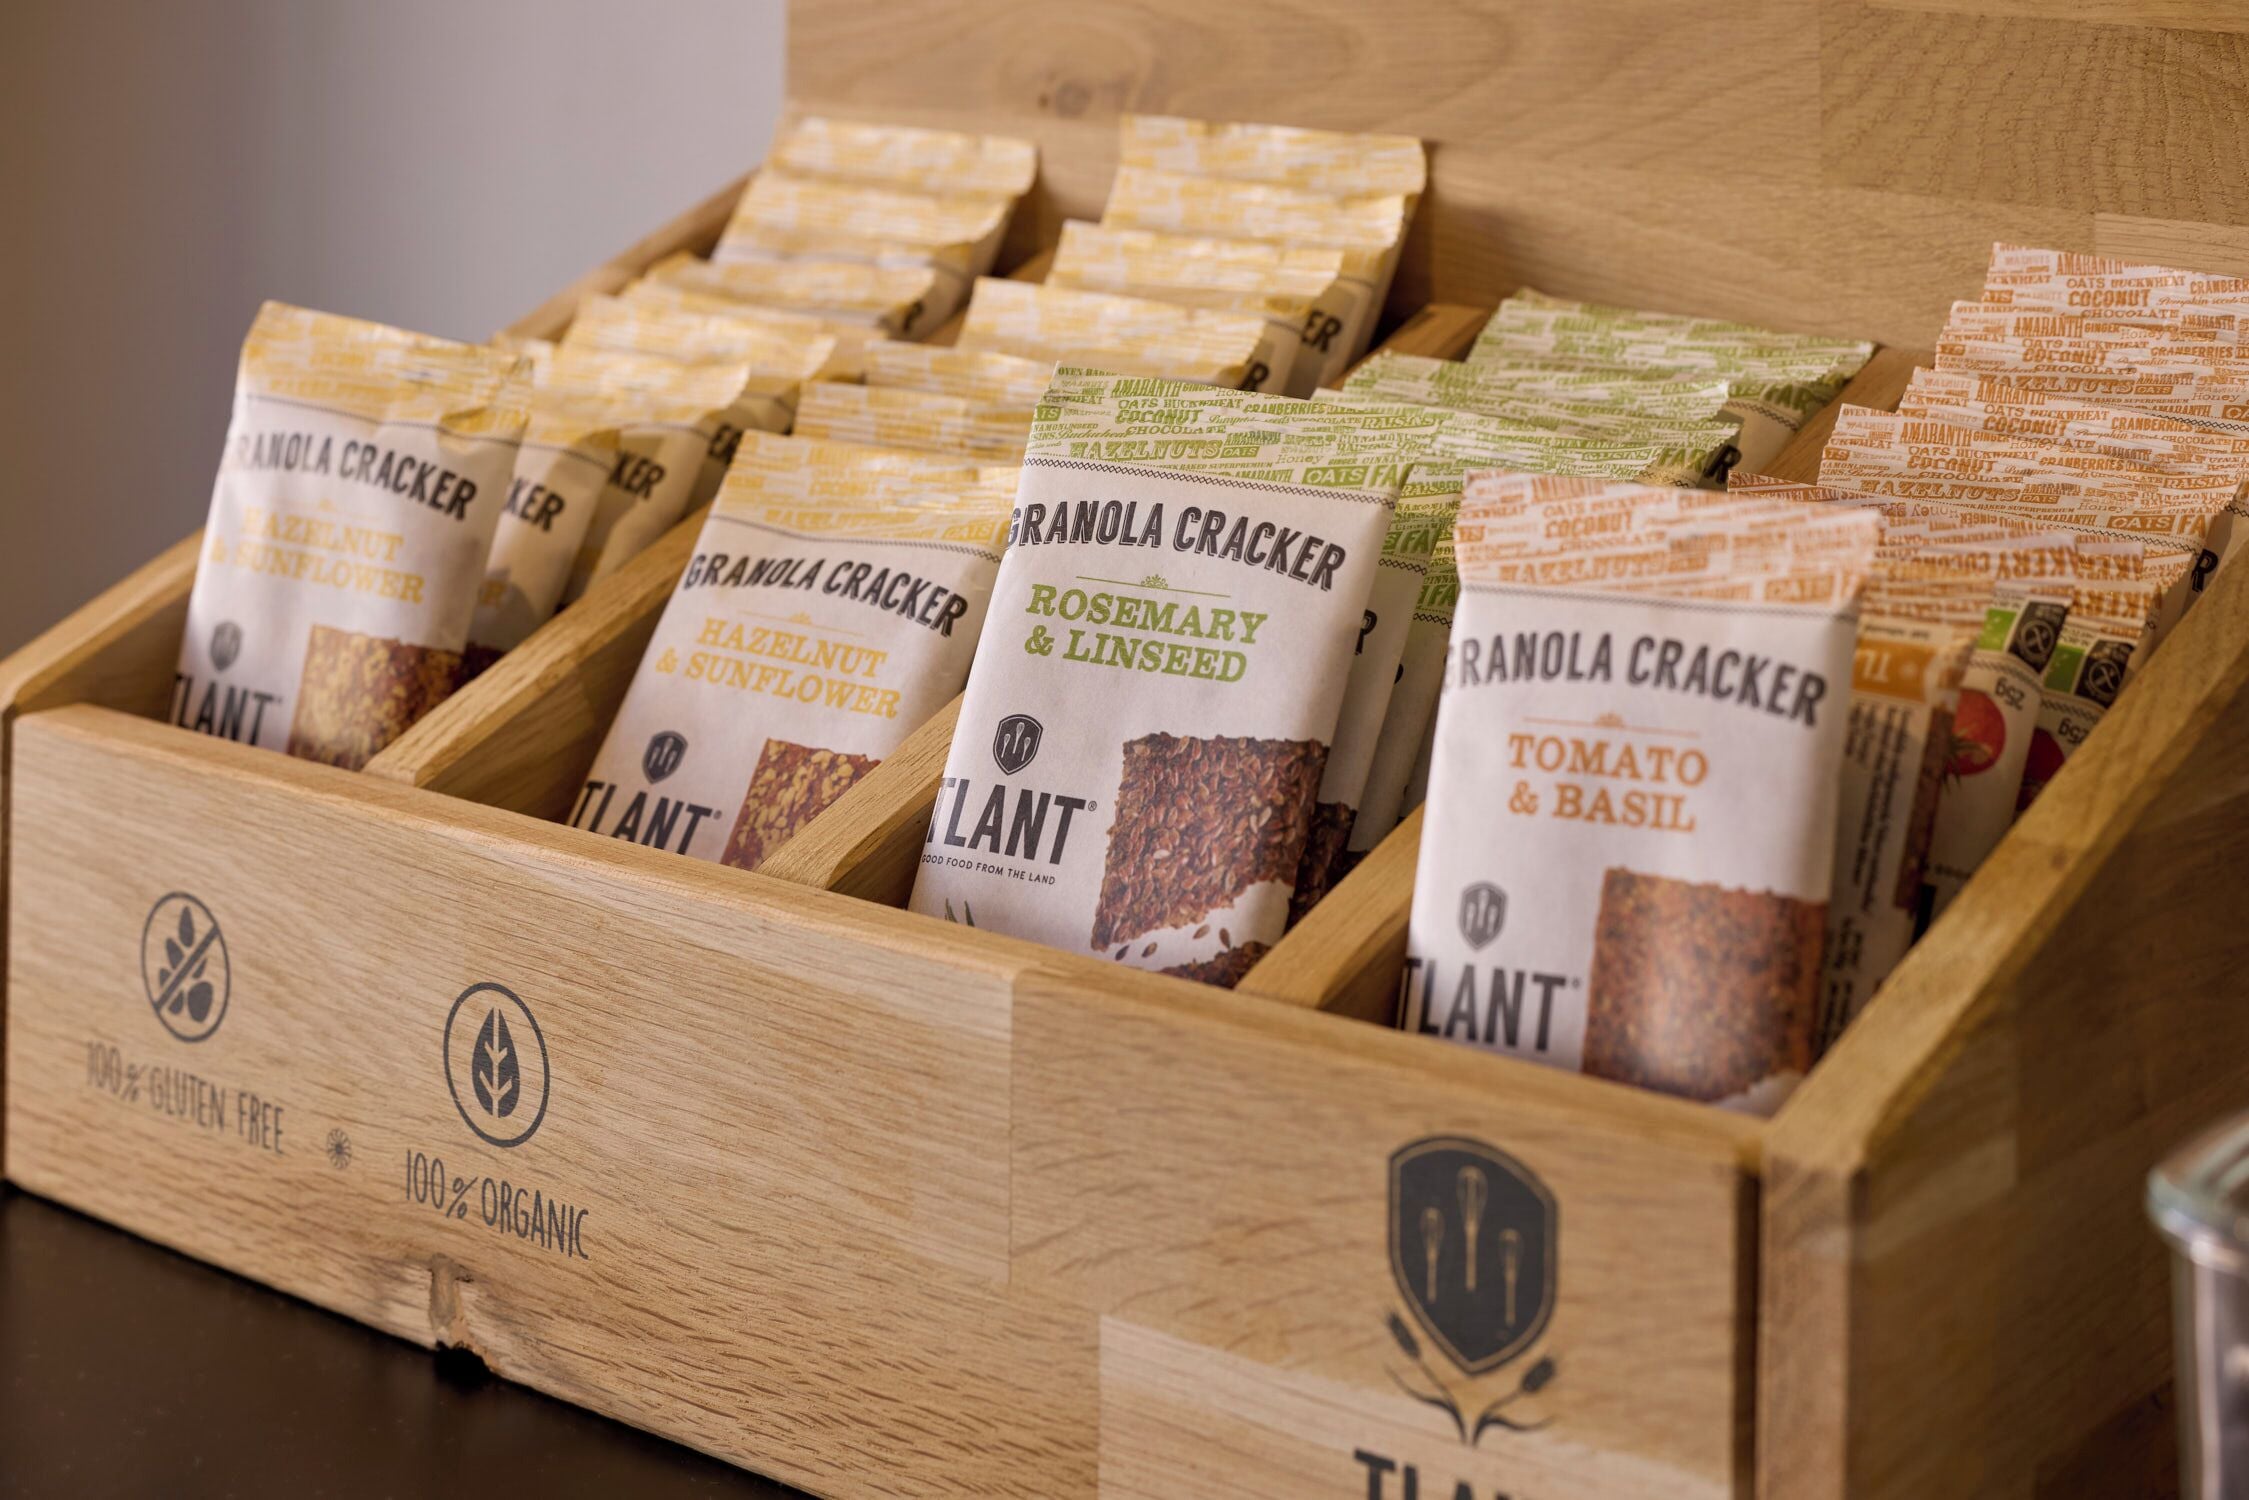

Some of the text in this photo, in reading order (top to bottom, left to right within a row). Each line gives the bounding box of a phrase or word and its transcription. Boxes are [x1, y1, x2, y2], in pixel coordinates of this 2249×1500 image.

[2066, 275, 2186, 289] OATS BUCKWHEAT
[2067, 290, 2151, 307] COCONUT
[2081, 310, 2180, 319] CHOCOLATE
[2013, 315, 2120, 338] AMARANTH GINGER
[2022, 338, 2064, 349] OATS
[1111, 379, 1180, 397] AMARANTH
[2191, 392, 2240, 403] Honey
[1118, 400, 1158, 409] OATS
[1842, 407, 1868, 417] OVEN
[1983, 404, 2110, 421] OATS BUCKWHEAT
[1115, 410, 1203, 424] COCONUT
[1982, 415, 2071, 436] COCONUT
[1125, 425, 1226, 435] CHOCOLATE
[1900, 421, 1973, 447] AMARANTH
[1069, 440, 1223, 460] HAZELNUTS
[1220, 447, 1260, 458] OATS
[1276, 453, 1324, 465] Honey
[1907, 446, 2039, 460] OATS BUCKWHEAT
[1906, 455, 1998, 474] COCONUT
[2039, 456, 2124, 472] CRANBERRIES
[228, 430, 478, 521] RANOLA CRACKER
[1302, 466, 1371, 486] OATS
[1860, 479, 2021, 502] HAZELNUTS
[2019, 494, 2061, 504] OATS
[2106, 513, 2176, 533] OATS
[241, 506, 404, 562] HAZELNUT
[1005, 500, 1347, 593] GRANOLA CRACKER
[232, 541, 426, 605] SUNFLOWER
[684, 553, 969, 638] GRANOLA CRACKER
[1025, 584, 1269, 645] ROSEMARY
[697, 617, 888, 679] HAZELNUT
[1024, 624, 1248, 683] & LINSEED
[655, 646, 901, 720] & SUNFLOWER
[1626, 634, 1828, 729] CRACKER
[1994, 676, 2025, 711] 25g
[1508, 732, 1710, 788] TOMATO
[1508, 779, 1698, 834] & BASIL
[921, 854, 1056, 885] GOOD FOOD FROM THE LAND
[86, 1041, 284, 1155] 100% GLUTEN FREE
[405, 1147, 590, 1260] 100% ORGANIC
